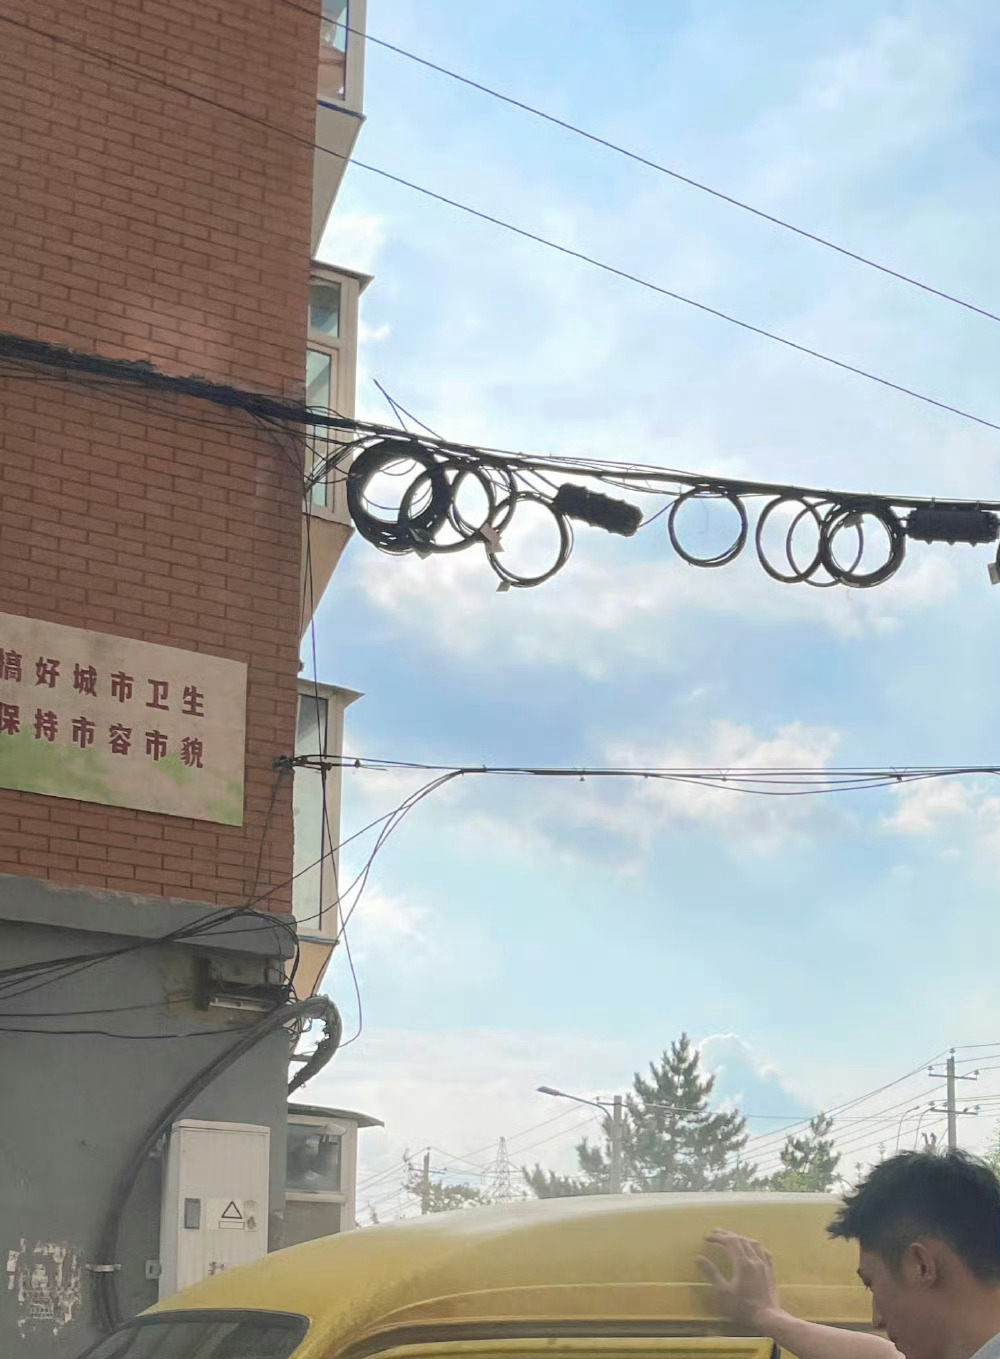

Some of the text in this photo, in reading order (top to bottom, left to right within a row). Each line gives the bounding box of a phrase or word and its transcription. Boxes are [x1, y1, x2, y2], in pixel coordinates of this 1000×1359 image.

[0, 647, 205, 718] 搞好城市卫生
[0, 703, 204, 769] 保持市容市貌
